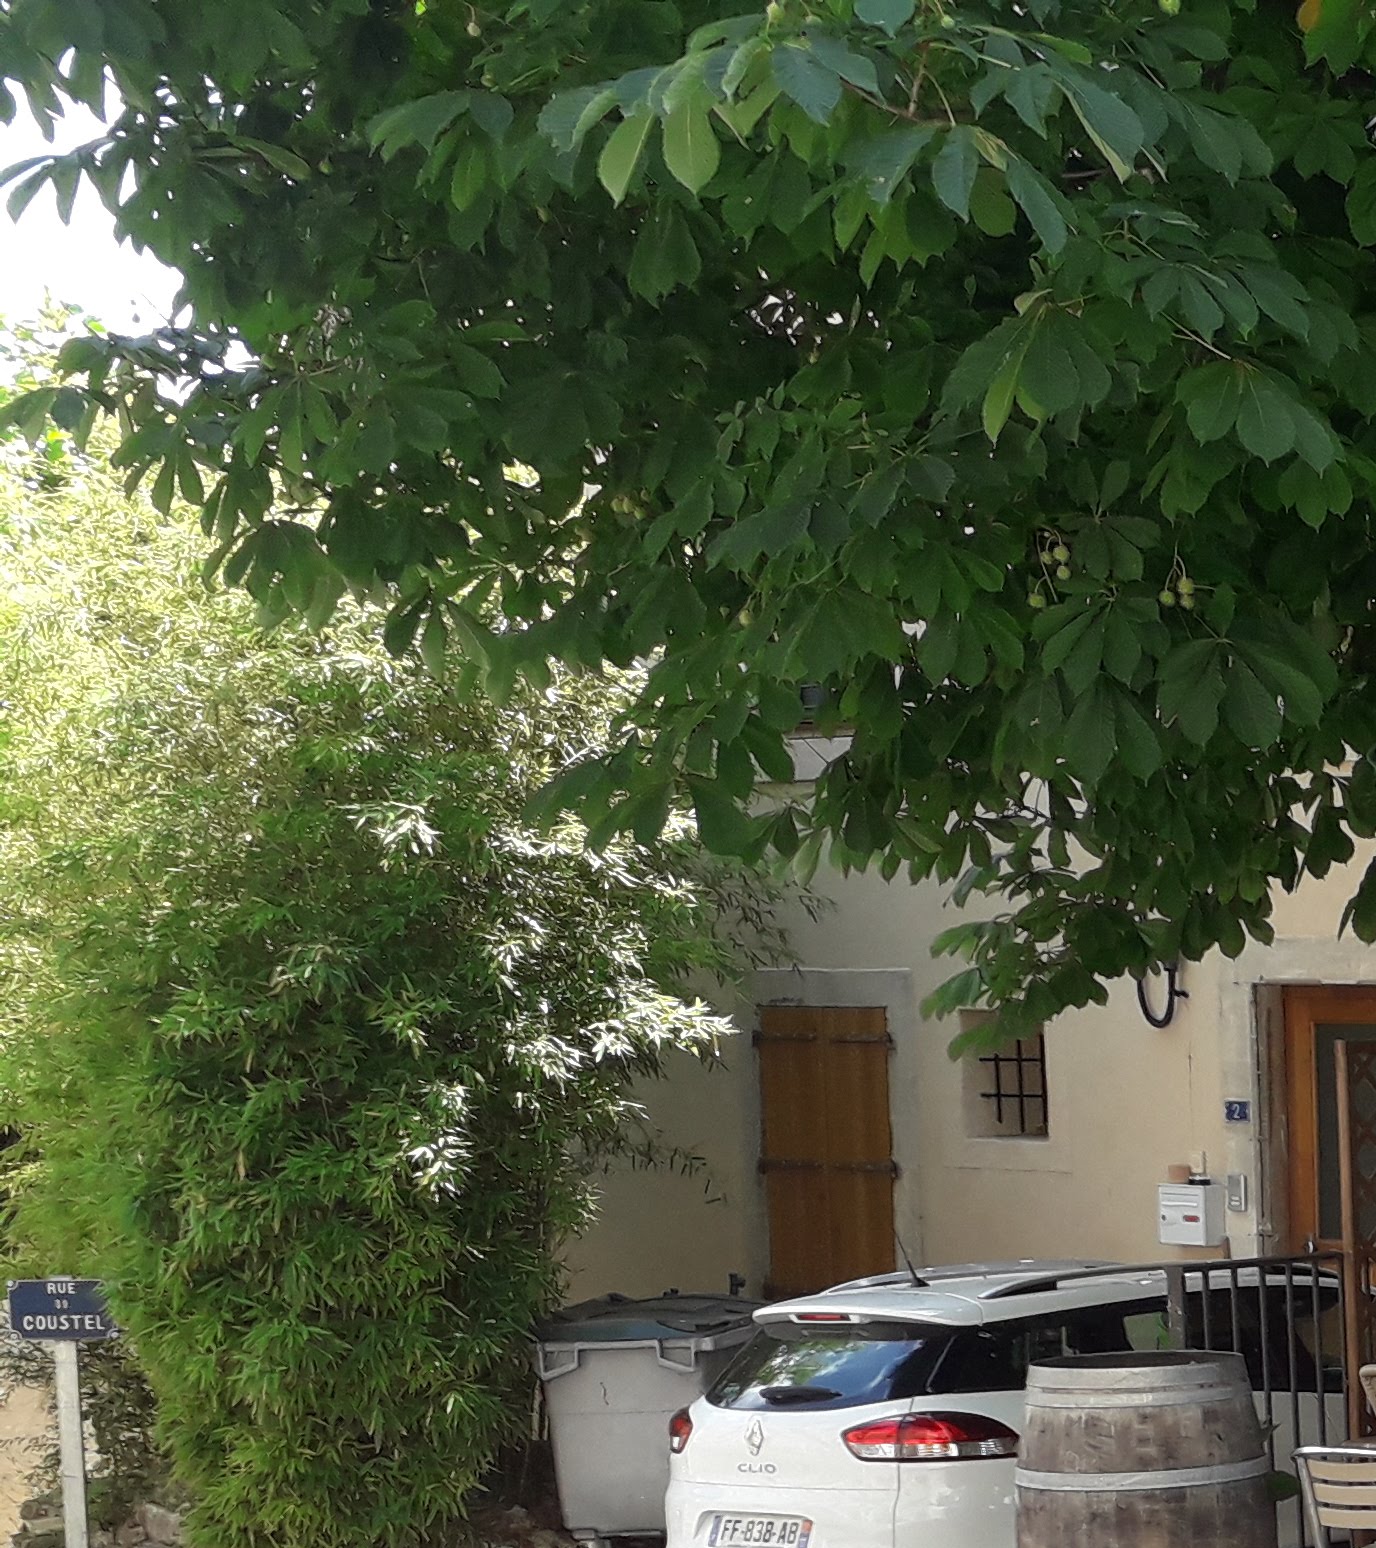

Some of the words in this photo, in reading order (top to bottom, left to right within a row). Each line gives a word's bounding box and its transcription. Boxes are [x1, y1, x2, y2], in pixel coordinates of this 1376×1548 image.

[1232, 1103, 1241, 1119] 2
[47, 1282, 76, 1295] RUE
[22, 1313, 106, 1331] COUSTEL
[737, 1463, 777, 1474] CLIO
[720, 1519, 800, 1545] FF-838-AB
